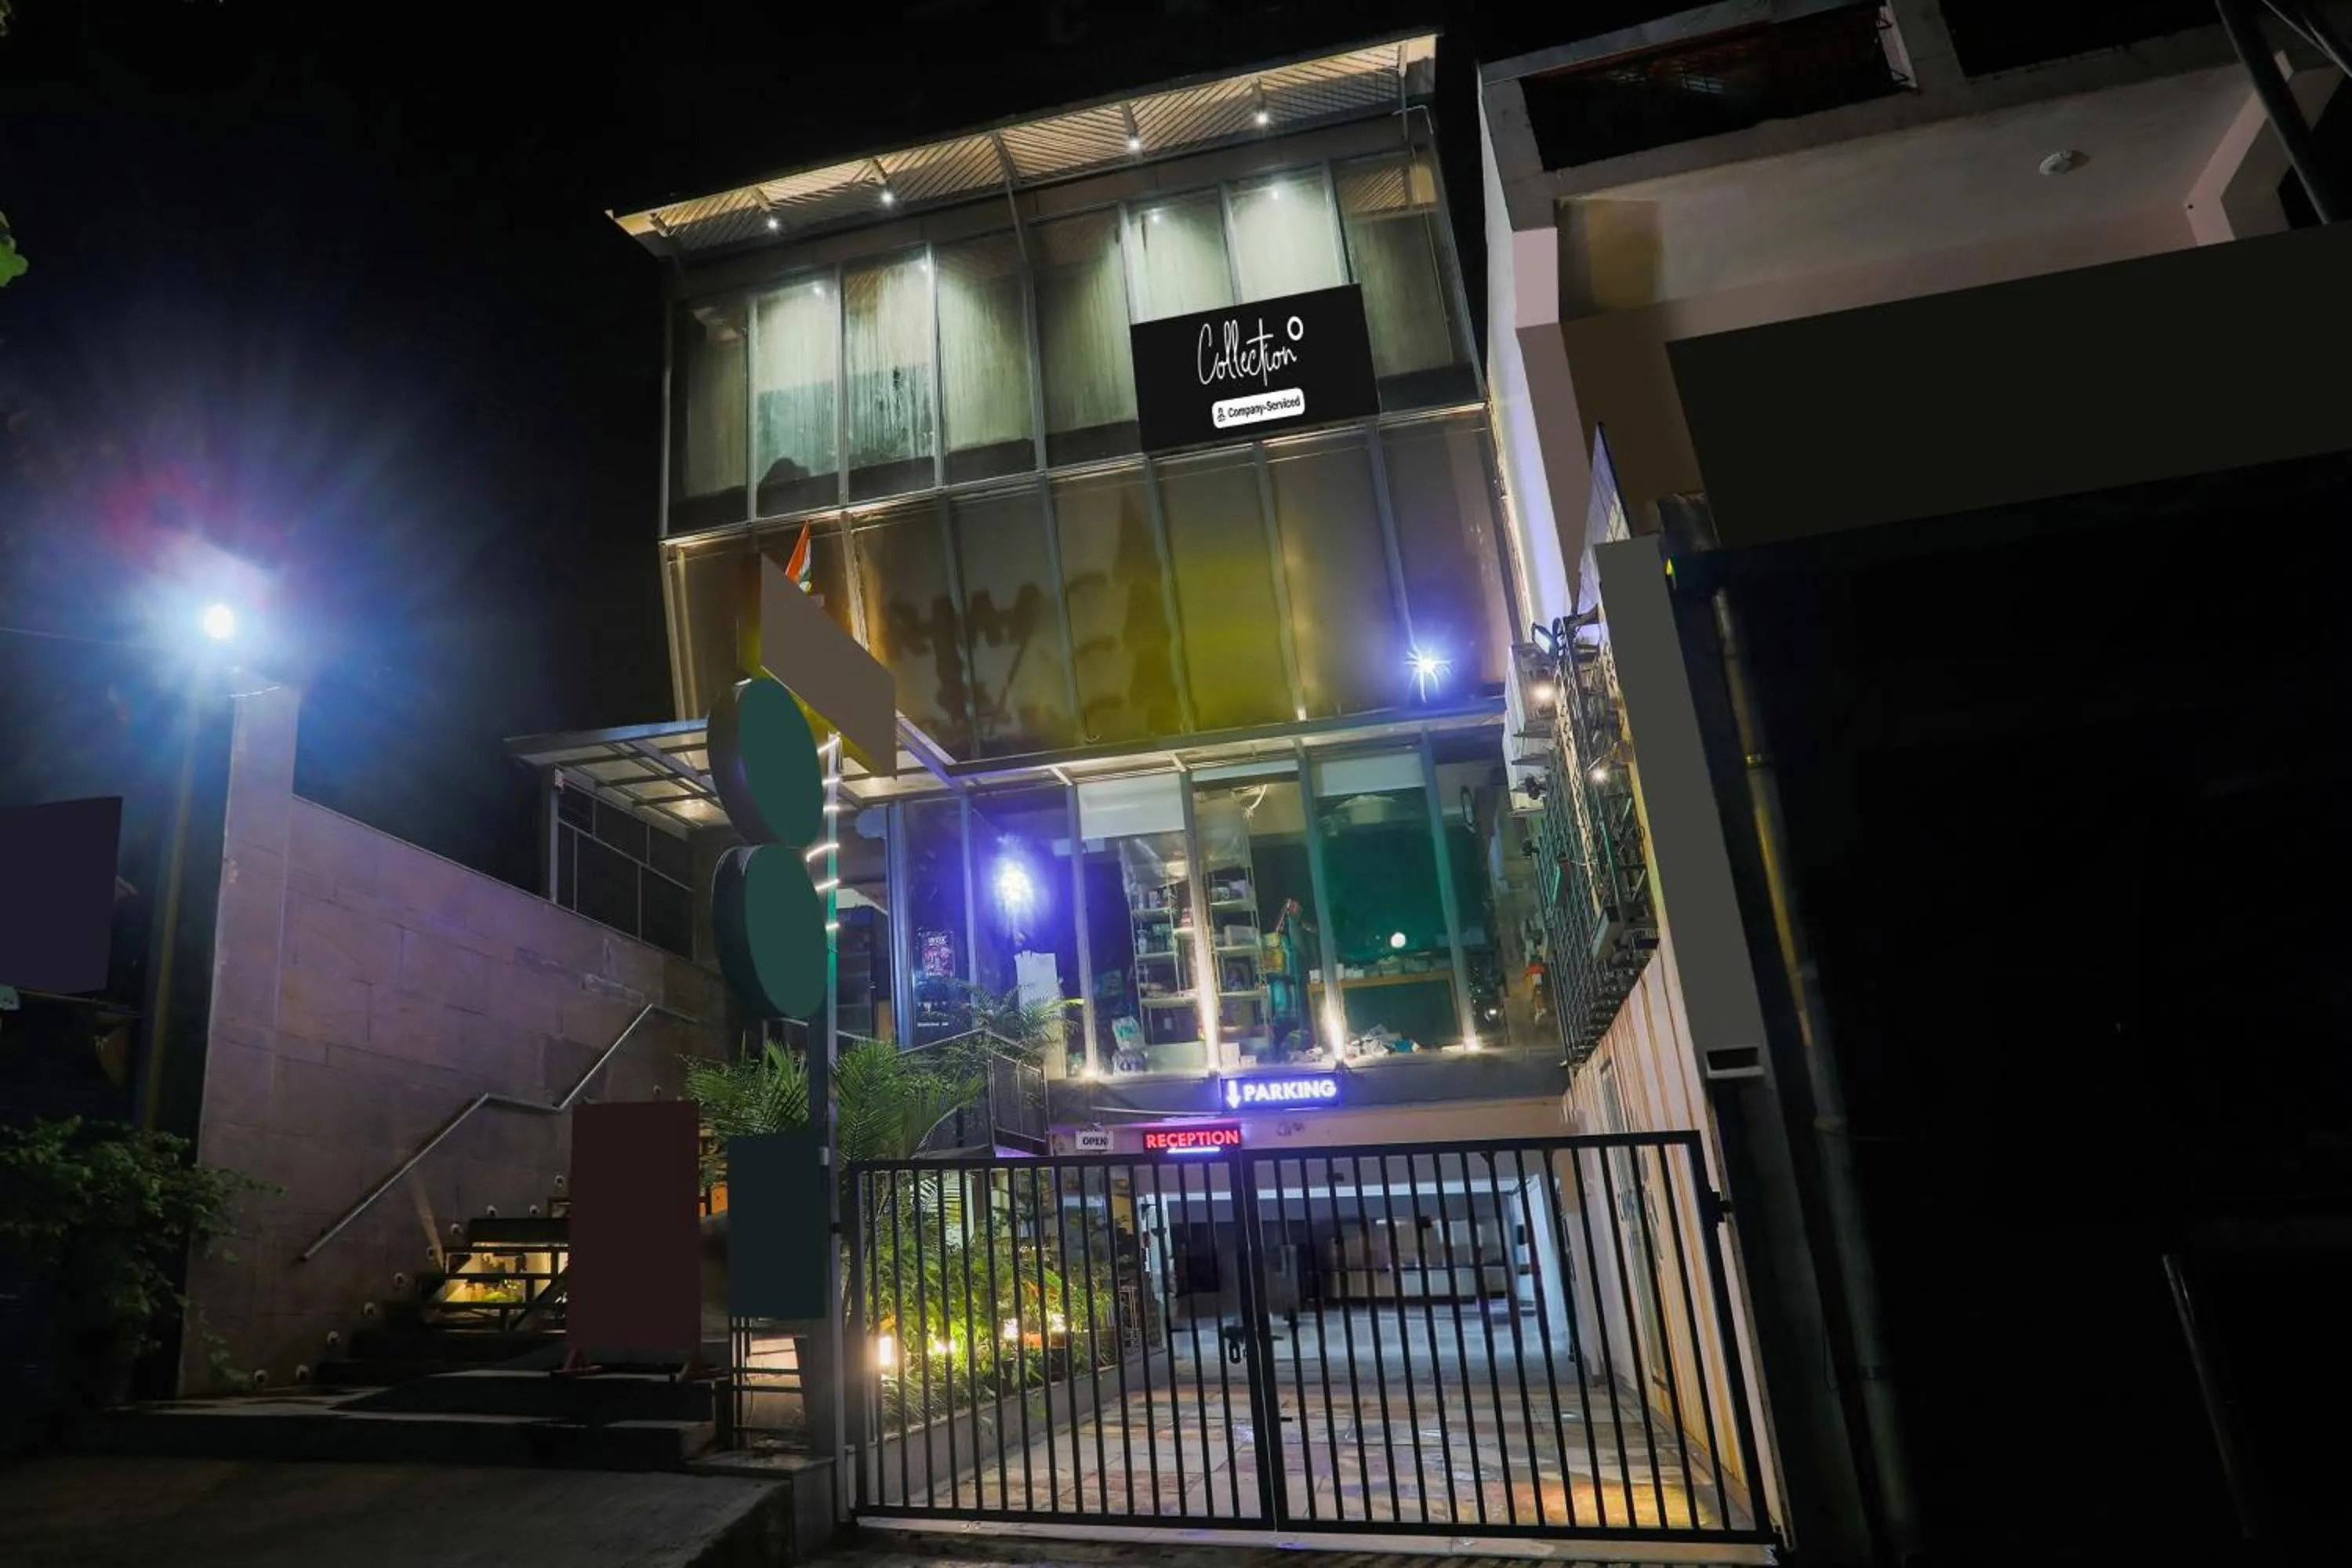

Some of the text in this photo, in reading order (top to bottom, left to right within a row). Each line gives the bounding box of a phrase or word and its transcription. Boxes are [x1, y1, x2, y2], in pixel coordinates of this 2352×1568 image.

[1197, 317, 1297, 387] Collection
[1227, 395, 1301, 418] Company-Serviced
[1243, 1080, 1337, 1102] PARKING
[1083, 1137, 1109, 1145] OPEN
[1146, 1129, 1240, 1149] RECEPTION
